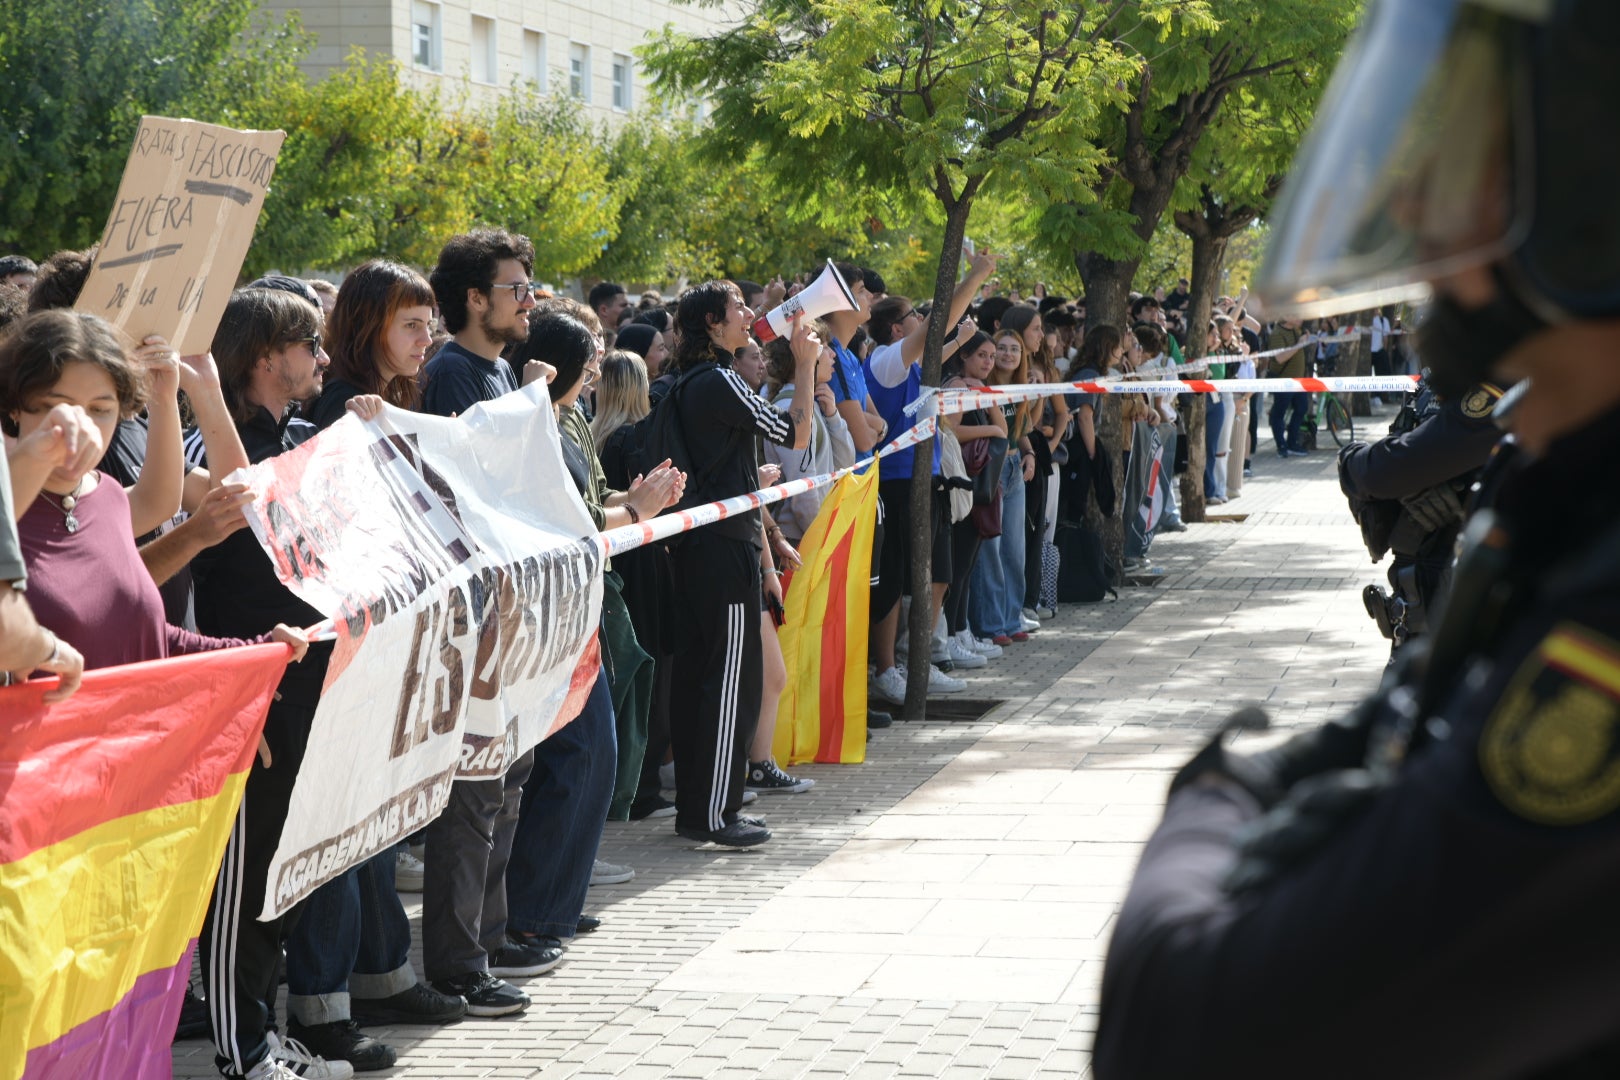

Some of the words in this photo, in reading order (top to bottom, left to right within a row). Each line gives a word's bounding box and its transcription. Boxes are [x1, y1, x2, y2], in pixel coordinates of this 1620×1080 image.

[136, 127, 189, 162] RATAS
[188, 131, 276, 189] FASCISTAS
[104, 193, 193, 251] FUERA
[106, 282, 129, 310] DE
[139, 286, 158, 306] LA
[177, 276, 208, 314] UA
[276, 828, 365, 905] ACABEN
[358, 802, 402, 855] AMB
[403, 790, 428, 827] LA
